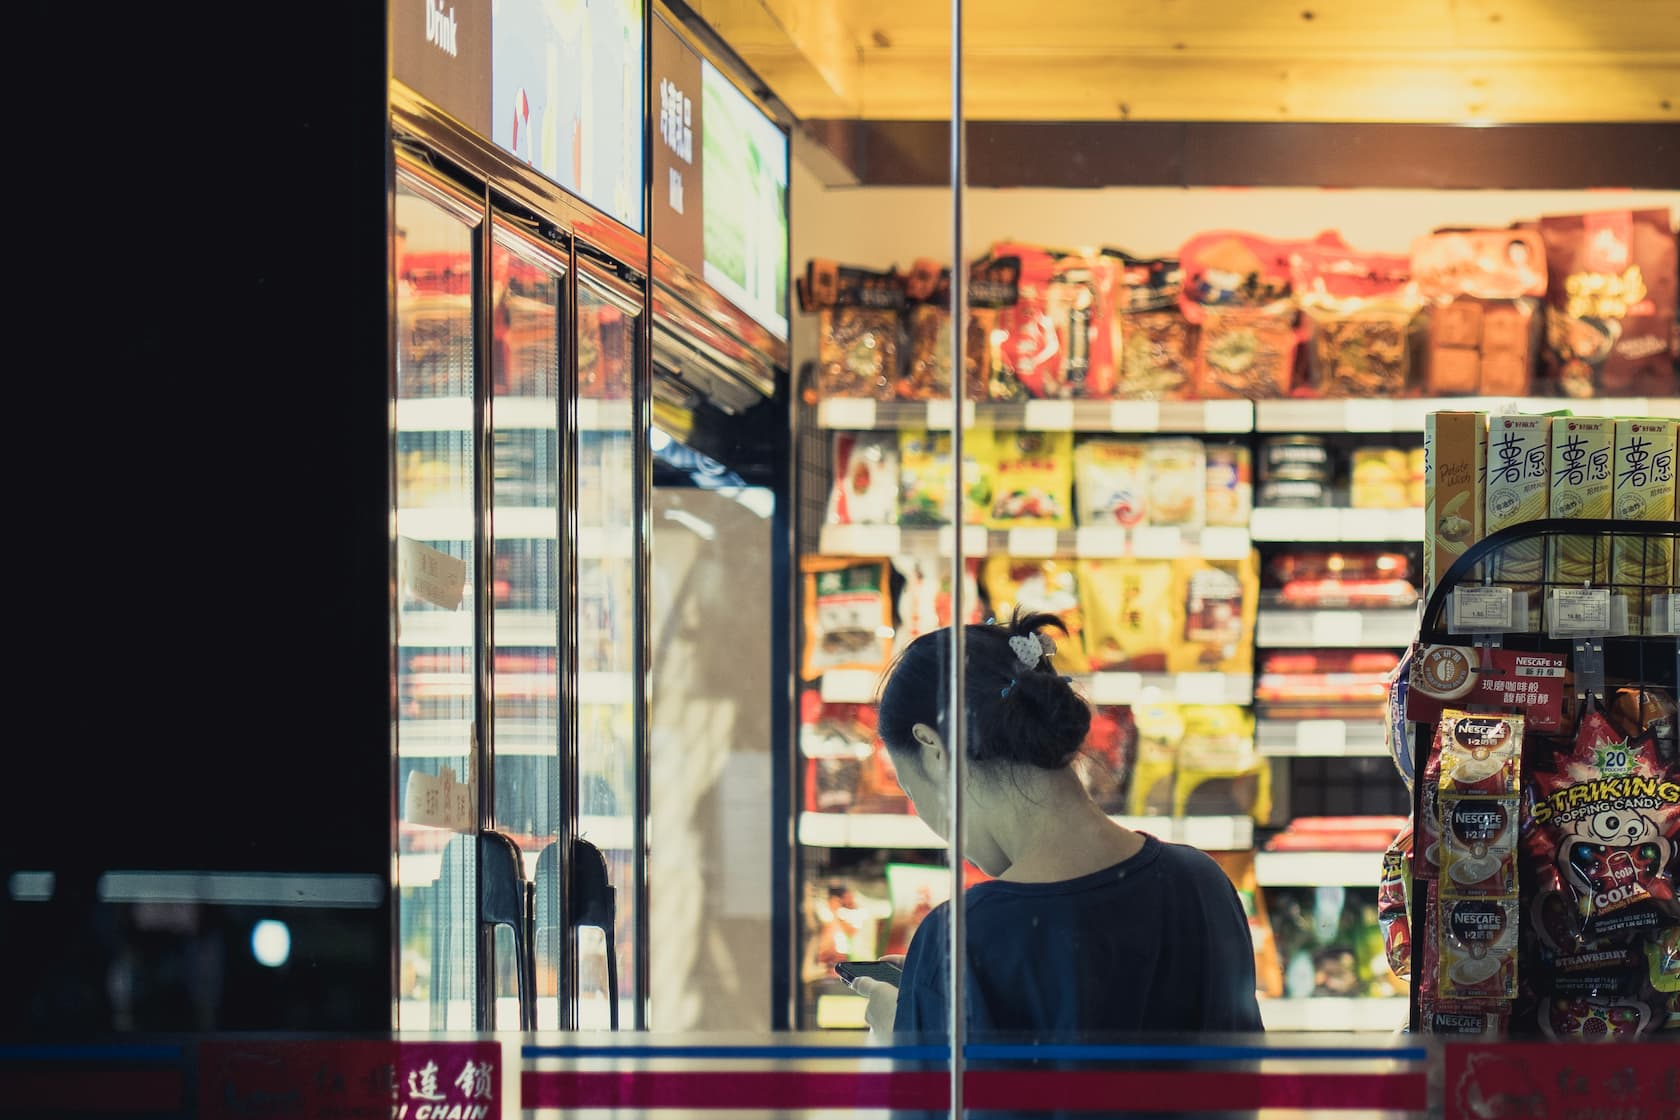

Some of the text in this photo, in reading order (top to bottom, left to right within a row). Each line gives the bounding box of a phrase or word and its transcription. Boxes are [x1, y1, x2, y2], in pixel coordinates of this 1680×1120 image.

[1489, 432, 1548, 484] 薯愿
[1553, 434, 1610, 487] 薯愿
[1617, 436, 1673, 489] 薯愿
[1482, 679, 1539, 693] 现磨咖啡般
[1606, 751, 1626, 767] 20
[1530, 774, 1680, 824] STRIKING
[1553, 798, 1664, 827] POPPING CANDY
[1595, 882, 1648, 908] COLA
